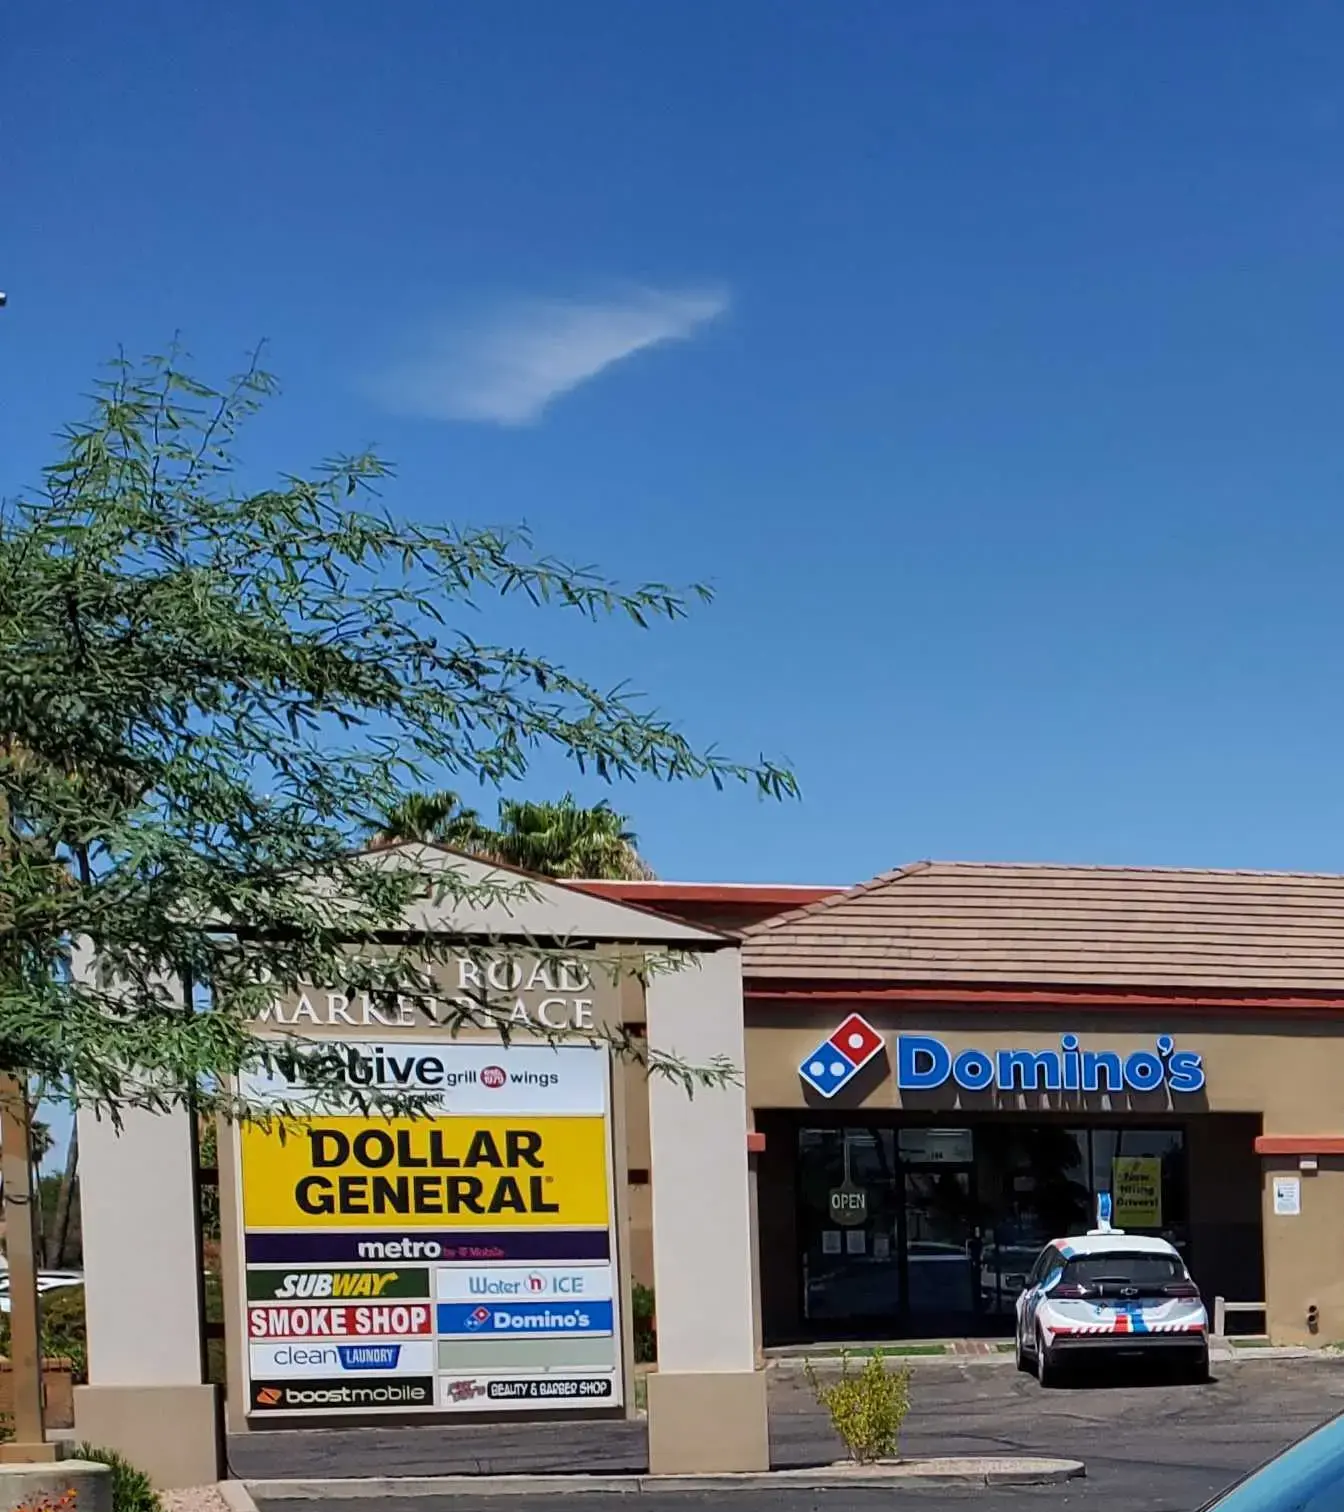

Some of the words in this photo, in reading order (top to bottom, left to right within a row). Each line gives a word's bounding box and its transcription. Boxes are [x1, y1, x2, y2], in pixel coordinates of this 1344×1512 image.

[457, 957, 591, 991] ROAD
[897, 1033, 1205, 1092] Domino's
[447, 1070, 477, 1086] grill
[510, 1071, 559, 1087] wings
[311, 1129, 545, 1169] DOLLAR
[294, 1175, 560, 1215] GENERAL
[831, 1194, 865, 1209] OPEN
[357, 1237, 442, 1259] metro
[274, 1271, 399, 1298] SUBWAY
[469, 1276, 521, 1294] Water
[553, 1276, 583, 1293] ICE
[251, 1308, 347, 1336] SMOKE
[355, 1306, 426, 1335] SHOP
[494, 1310, 590, 1329] Domino's
[274, 1346, 337, 1365] clean
[346, 1348, 394, 1363] LAUNDRY
[490, 1383, 528, 1397] BEAUTY
[530, 1382, 538, 1396] &
[539, 1381, 577, 1395] BARBER
[580, 1380, 607, 1395] SHOP
